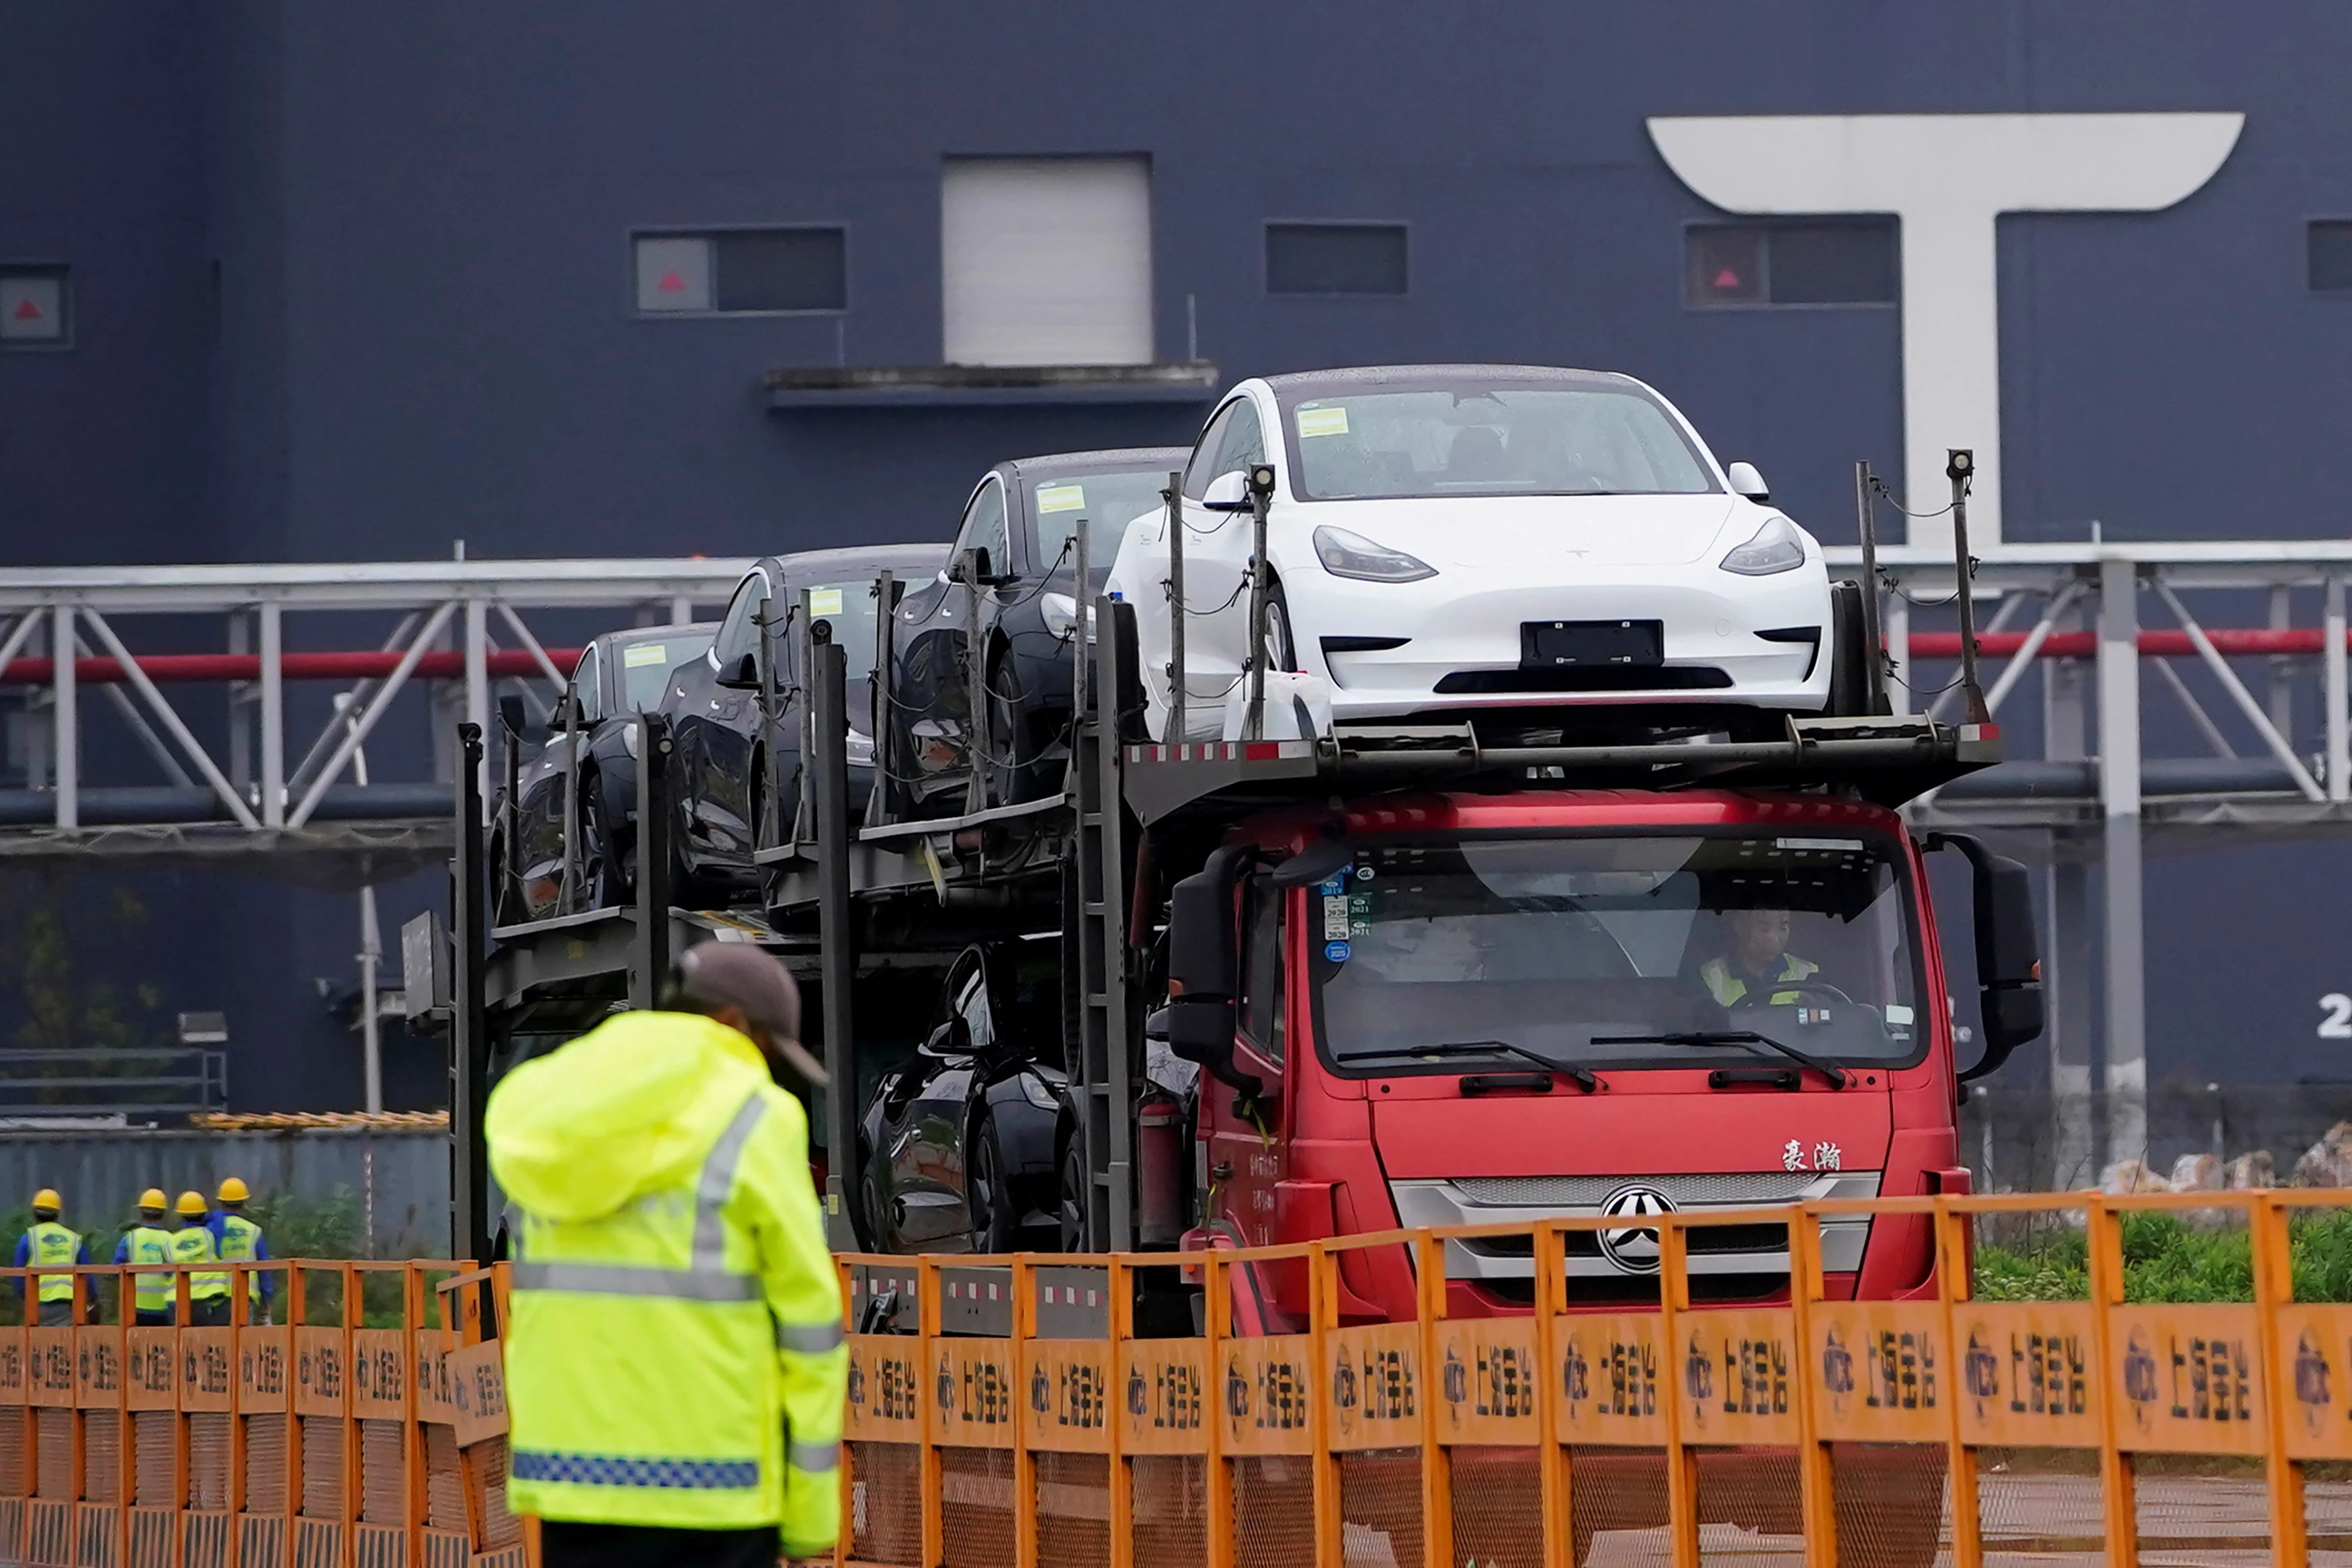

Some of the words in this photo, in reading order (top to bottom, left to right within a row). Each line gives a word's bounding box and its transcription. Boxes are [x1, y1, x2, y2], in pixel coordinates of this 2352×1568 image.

[1327, 909, 1347, 917] 2020
[2316, 992, 2352, 1039] 2
[1781, 1139, 1842, 1172] 豪瀚
